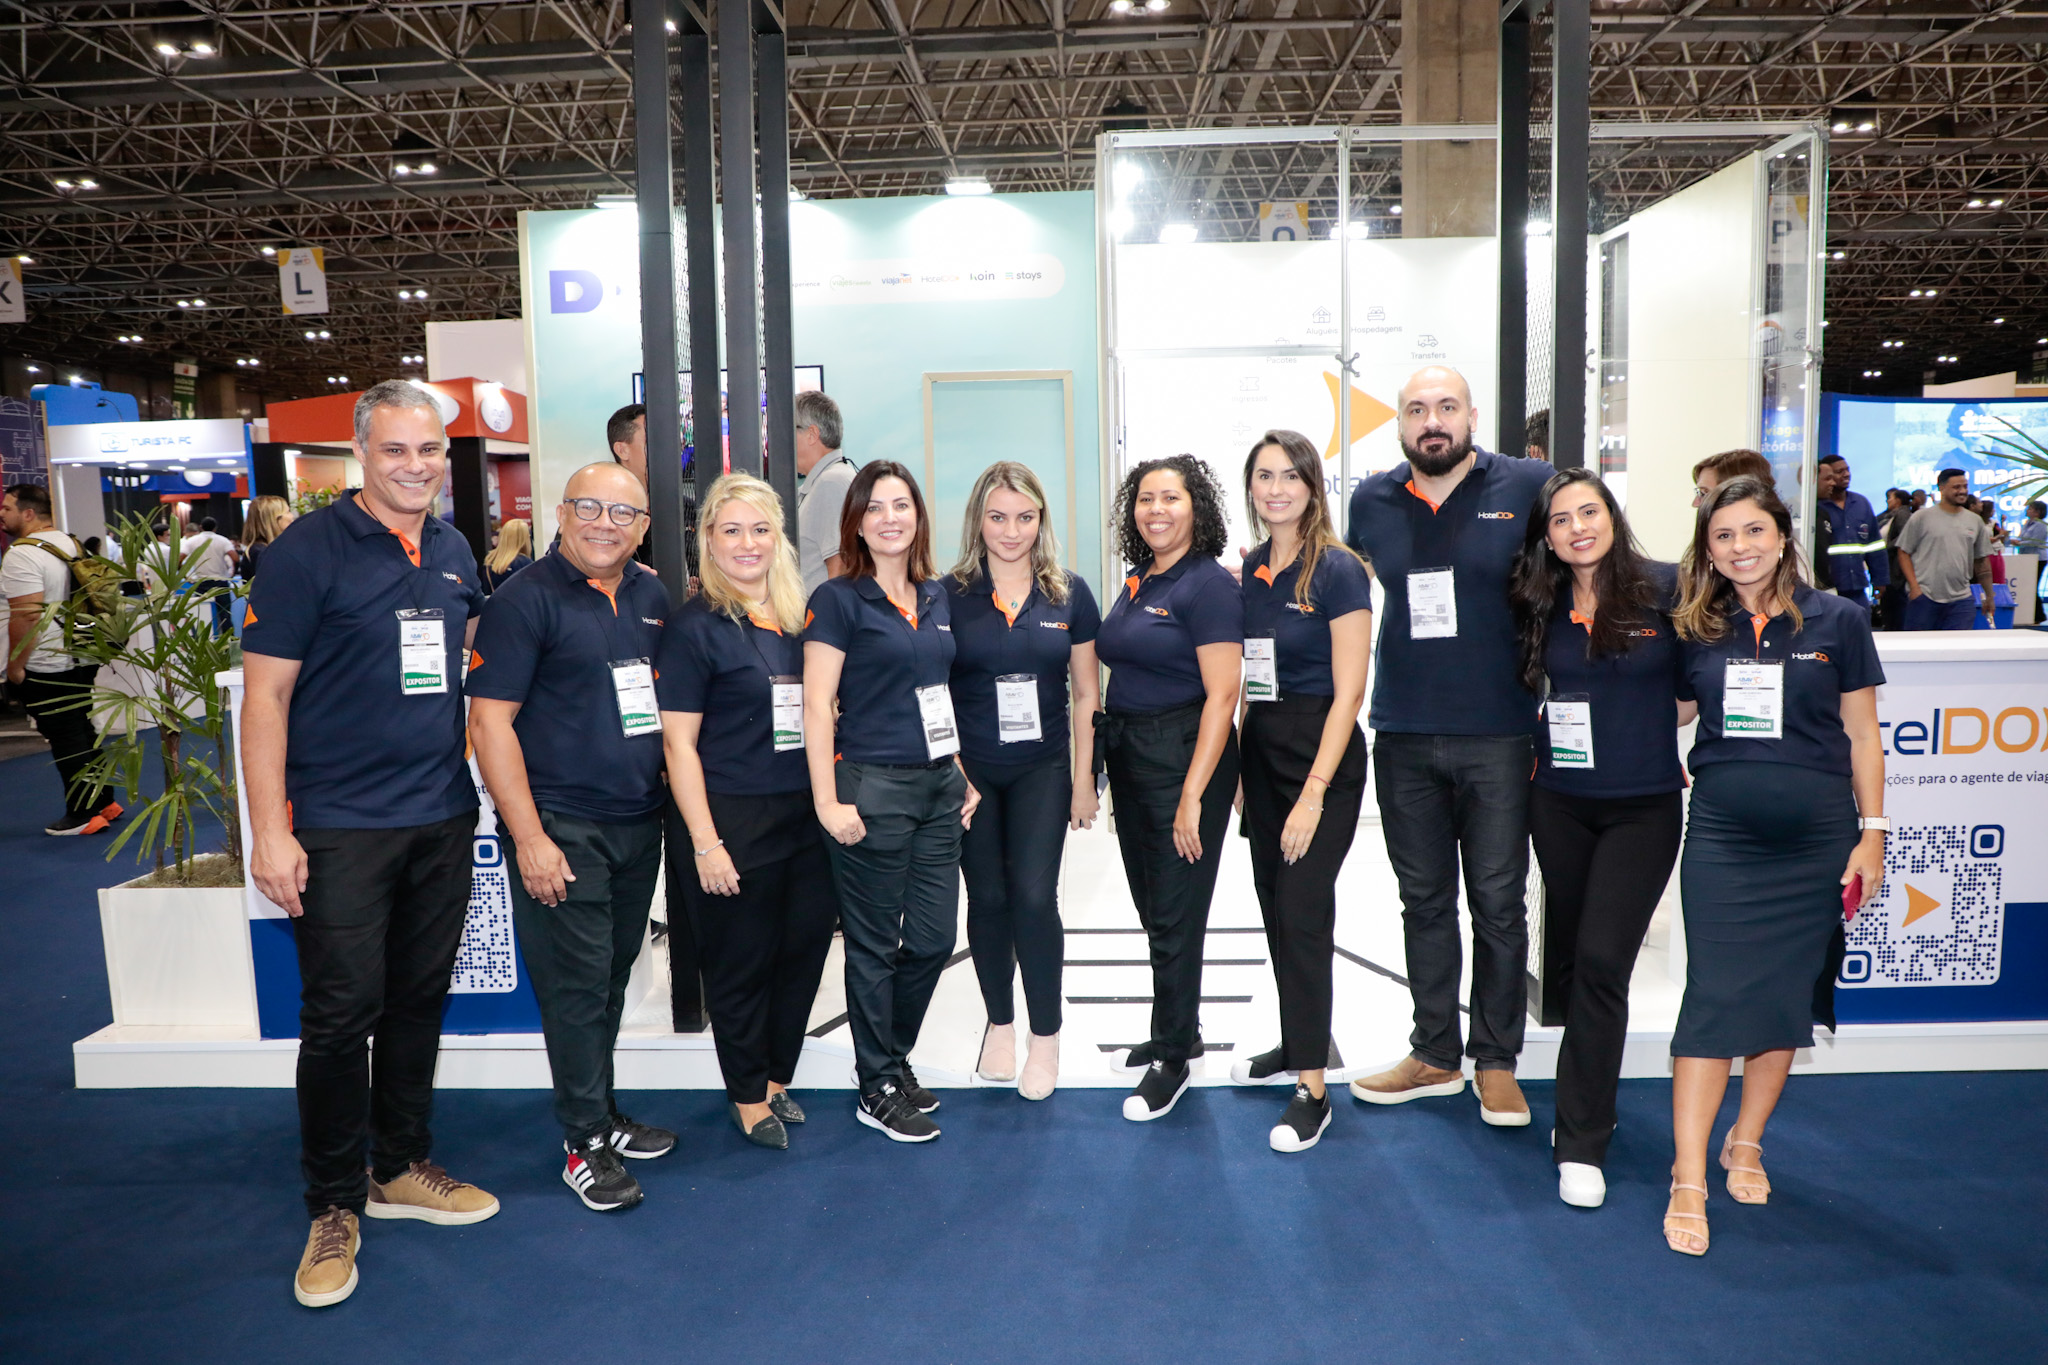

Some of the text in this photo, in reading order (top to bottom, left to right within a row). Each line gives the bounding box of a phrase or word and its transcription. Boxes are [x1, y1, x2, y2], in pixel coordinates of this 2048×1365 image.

[1772, 220, 1792, 244] P
[1016, 271, 1042, 281] stays
[295, 272, 313, 295] L
[1350, 324, 1403, 334] Hospedagens
[1411, 351, 1446, 360] Transfers
[131, 437, 175, 446] TURISTA
[1232, 439, 1251, 447] Voos
[1478, 511, 1512, 519] HotelDO
[1040, 621, 1068, 630] HotelDO
[1792, 652, 1829, 662] HotelDO
[406, 676, 440, 686] EXPOSITOR
[1248, 685, 1271, 693] EXPOSITOR
[625, 716, 657, 726] EXPOSITOR
[1727, 721, 1772, 729] EXPOSITOR
[1553, 752, 1586, 760] EXPOSITOR
[1918, 775, 1946, 786] para
[1949, 775, 1958, 784] o
[1961, 772, 2004, 785] agente
[2007, 770, 2023, 782] de
